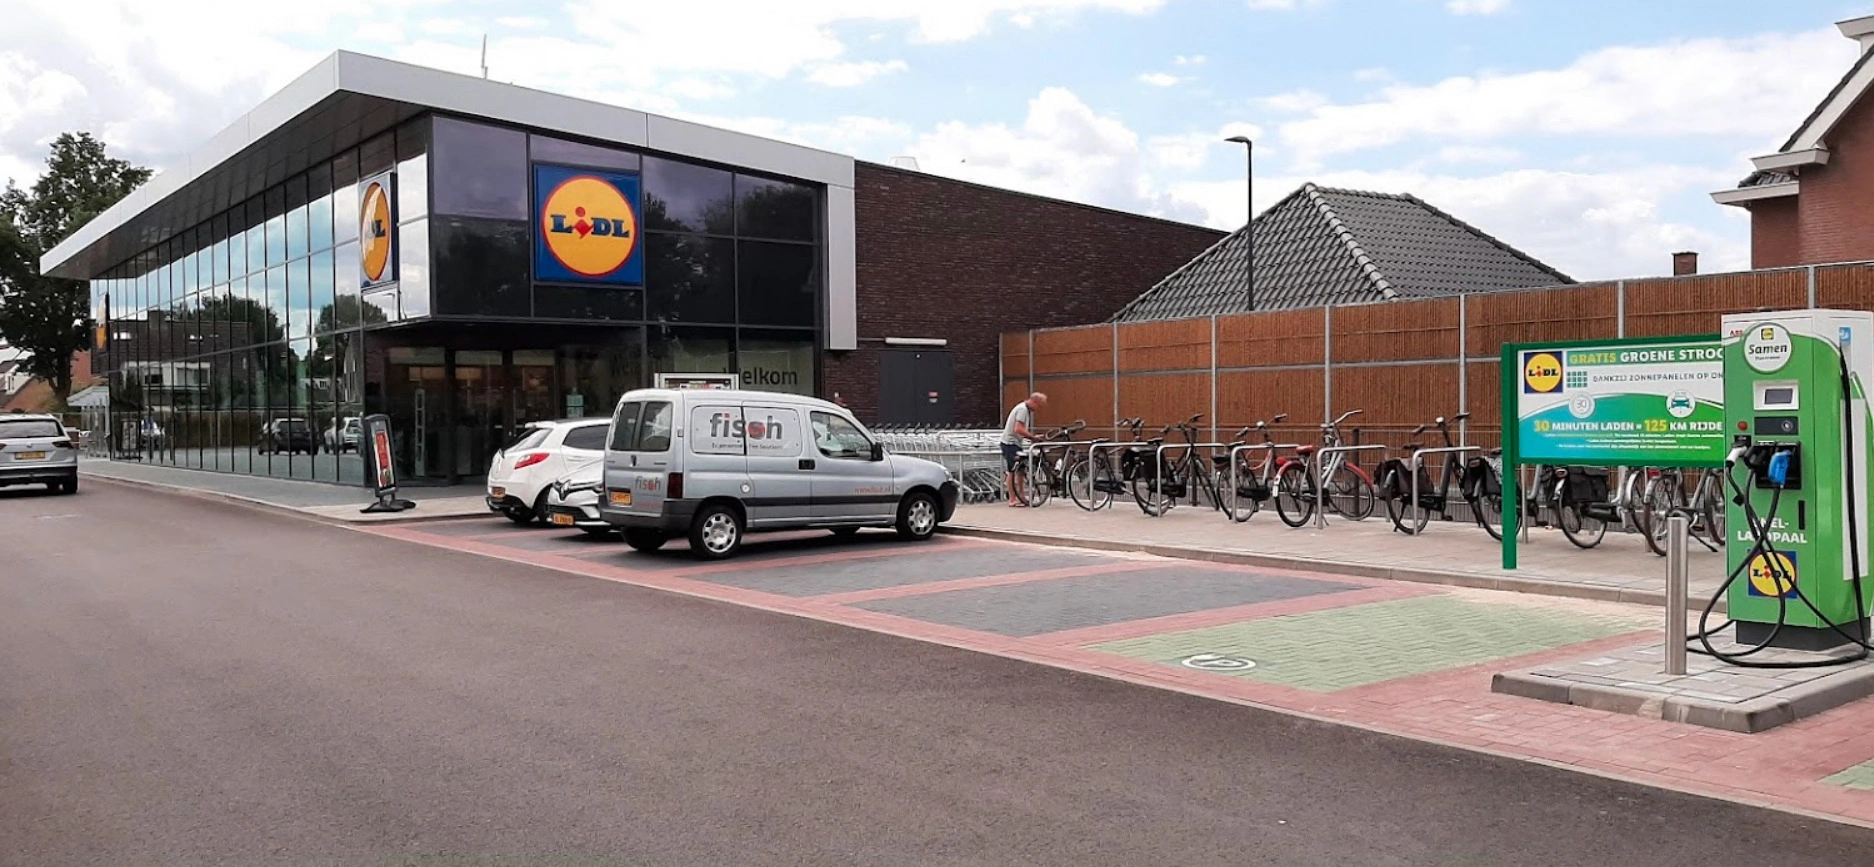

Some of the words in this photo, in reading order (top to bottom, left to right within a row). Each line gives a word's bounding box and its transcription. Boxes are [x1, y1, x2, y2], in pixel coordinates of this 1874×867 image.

[1749, 344, 1787, 354] Samen
[1569, 352, 1616, 365] GRATIS
[1620, 350, 1675, 363] GROENE
[723, 367, 797, 385] elkom
[1593, 374, 1626, 383] DANKZIJ
[1629, 373, 1694, 382] ZONNEPANELEN
[1697, 372, 1709, 380] OP
[1533, 420, 1550, 432] 30
[1552, 422, 1599, 431] MINUTEN
[1600, 422, 1634, 431] LADEN
[1644, 420, 1666, 432] 125
[1669, 422, 1687, 431] KM
